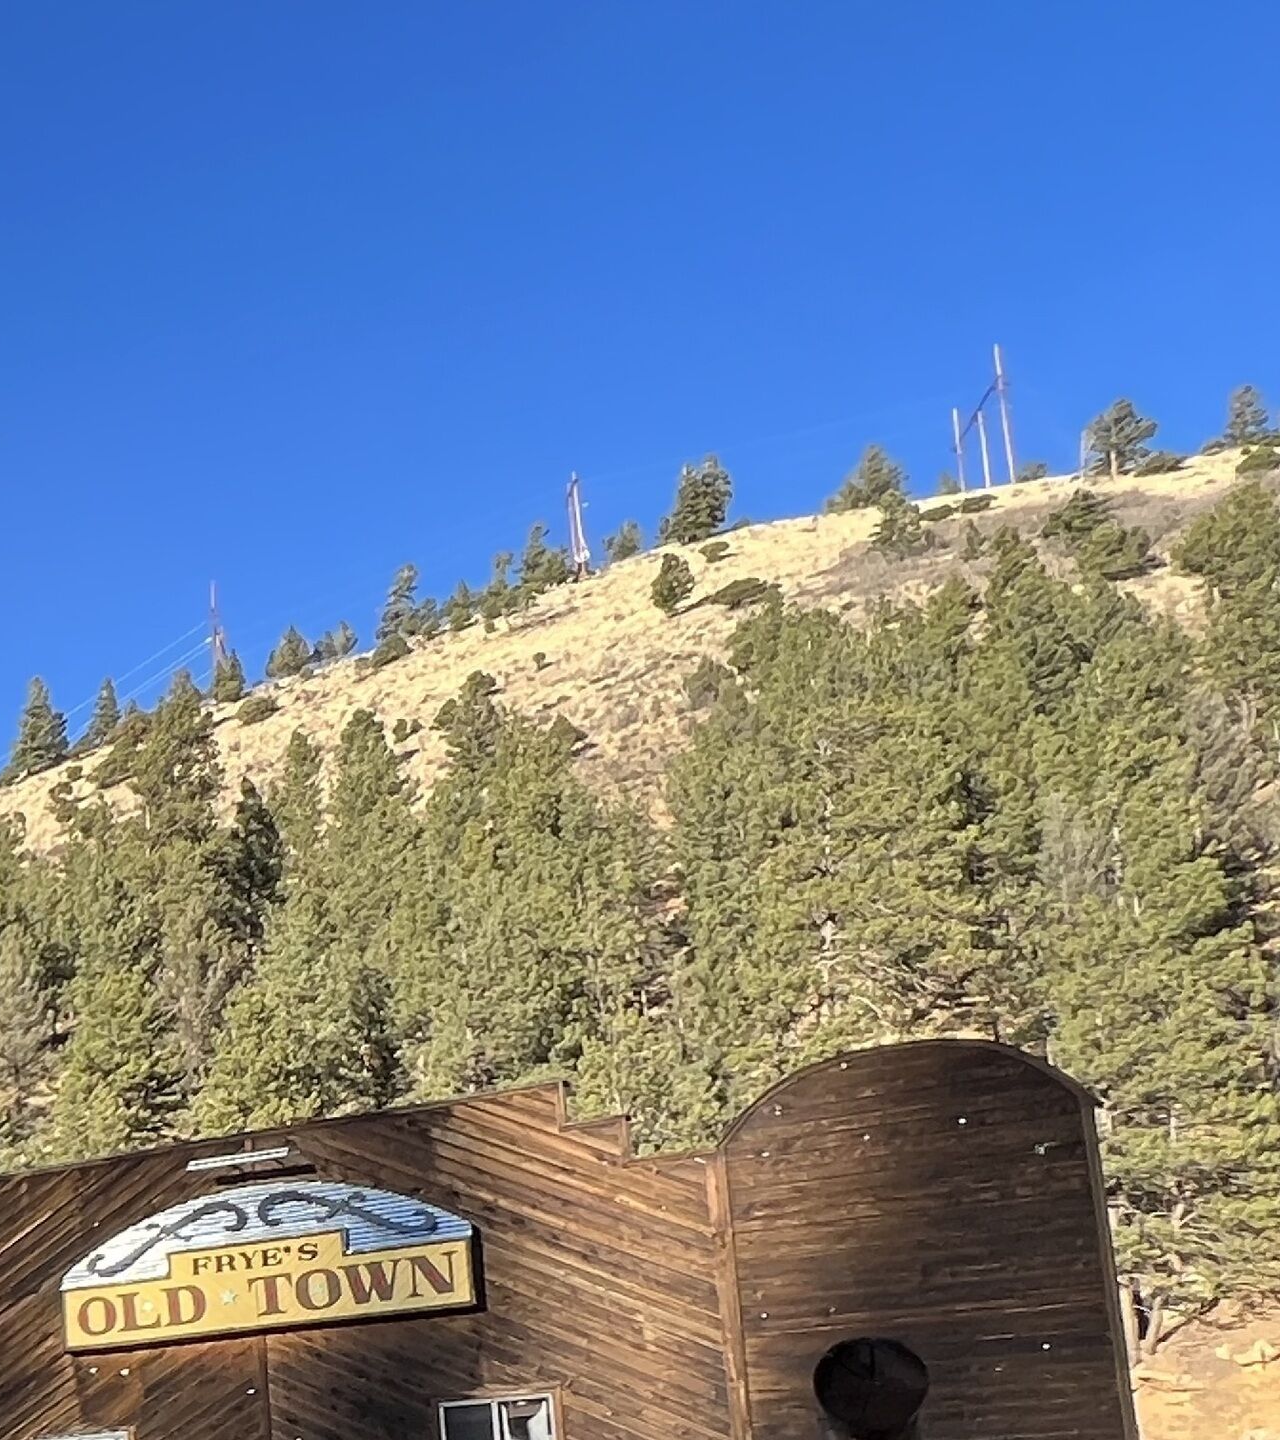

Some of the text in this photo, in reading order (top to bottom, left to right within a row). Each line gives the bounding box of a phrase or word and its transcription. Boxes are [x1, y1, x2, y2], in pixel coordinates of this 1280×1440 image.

[192, 1242, 319, 1276] FRYE'S
[77, 1250, 459, 1336] OLD TOWN
